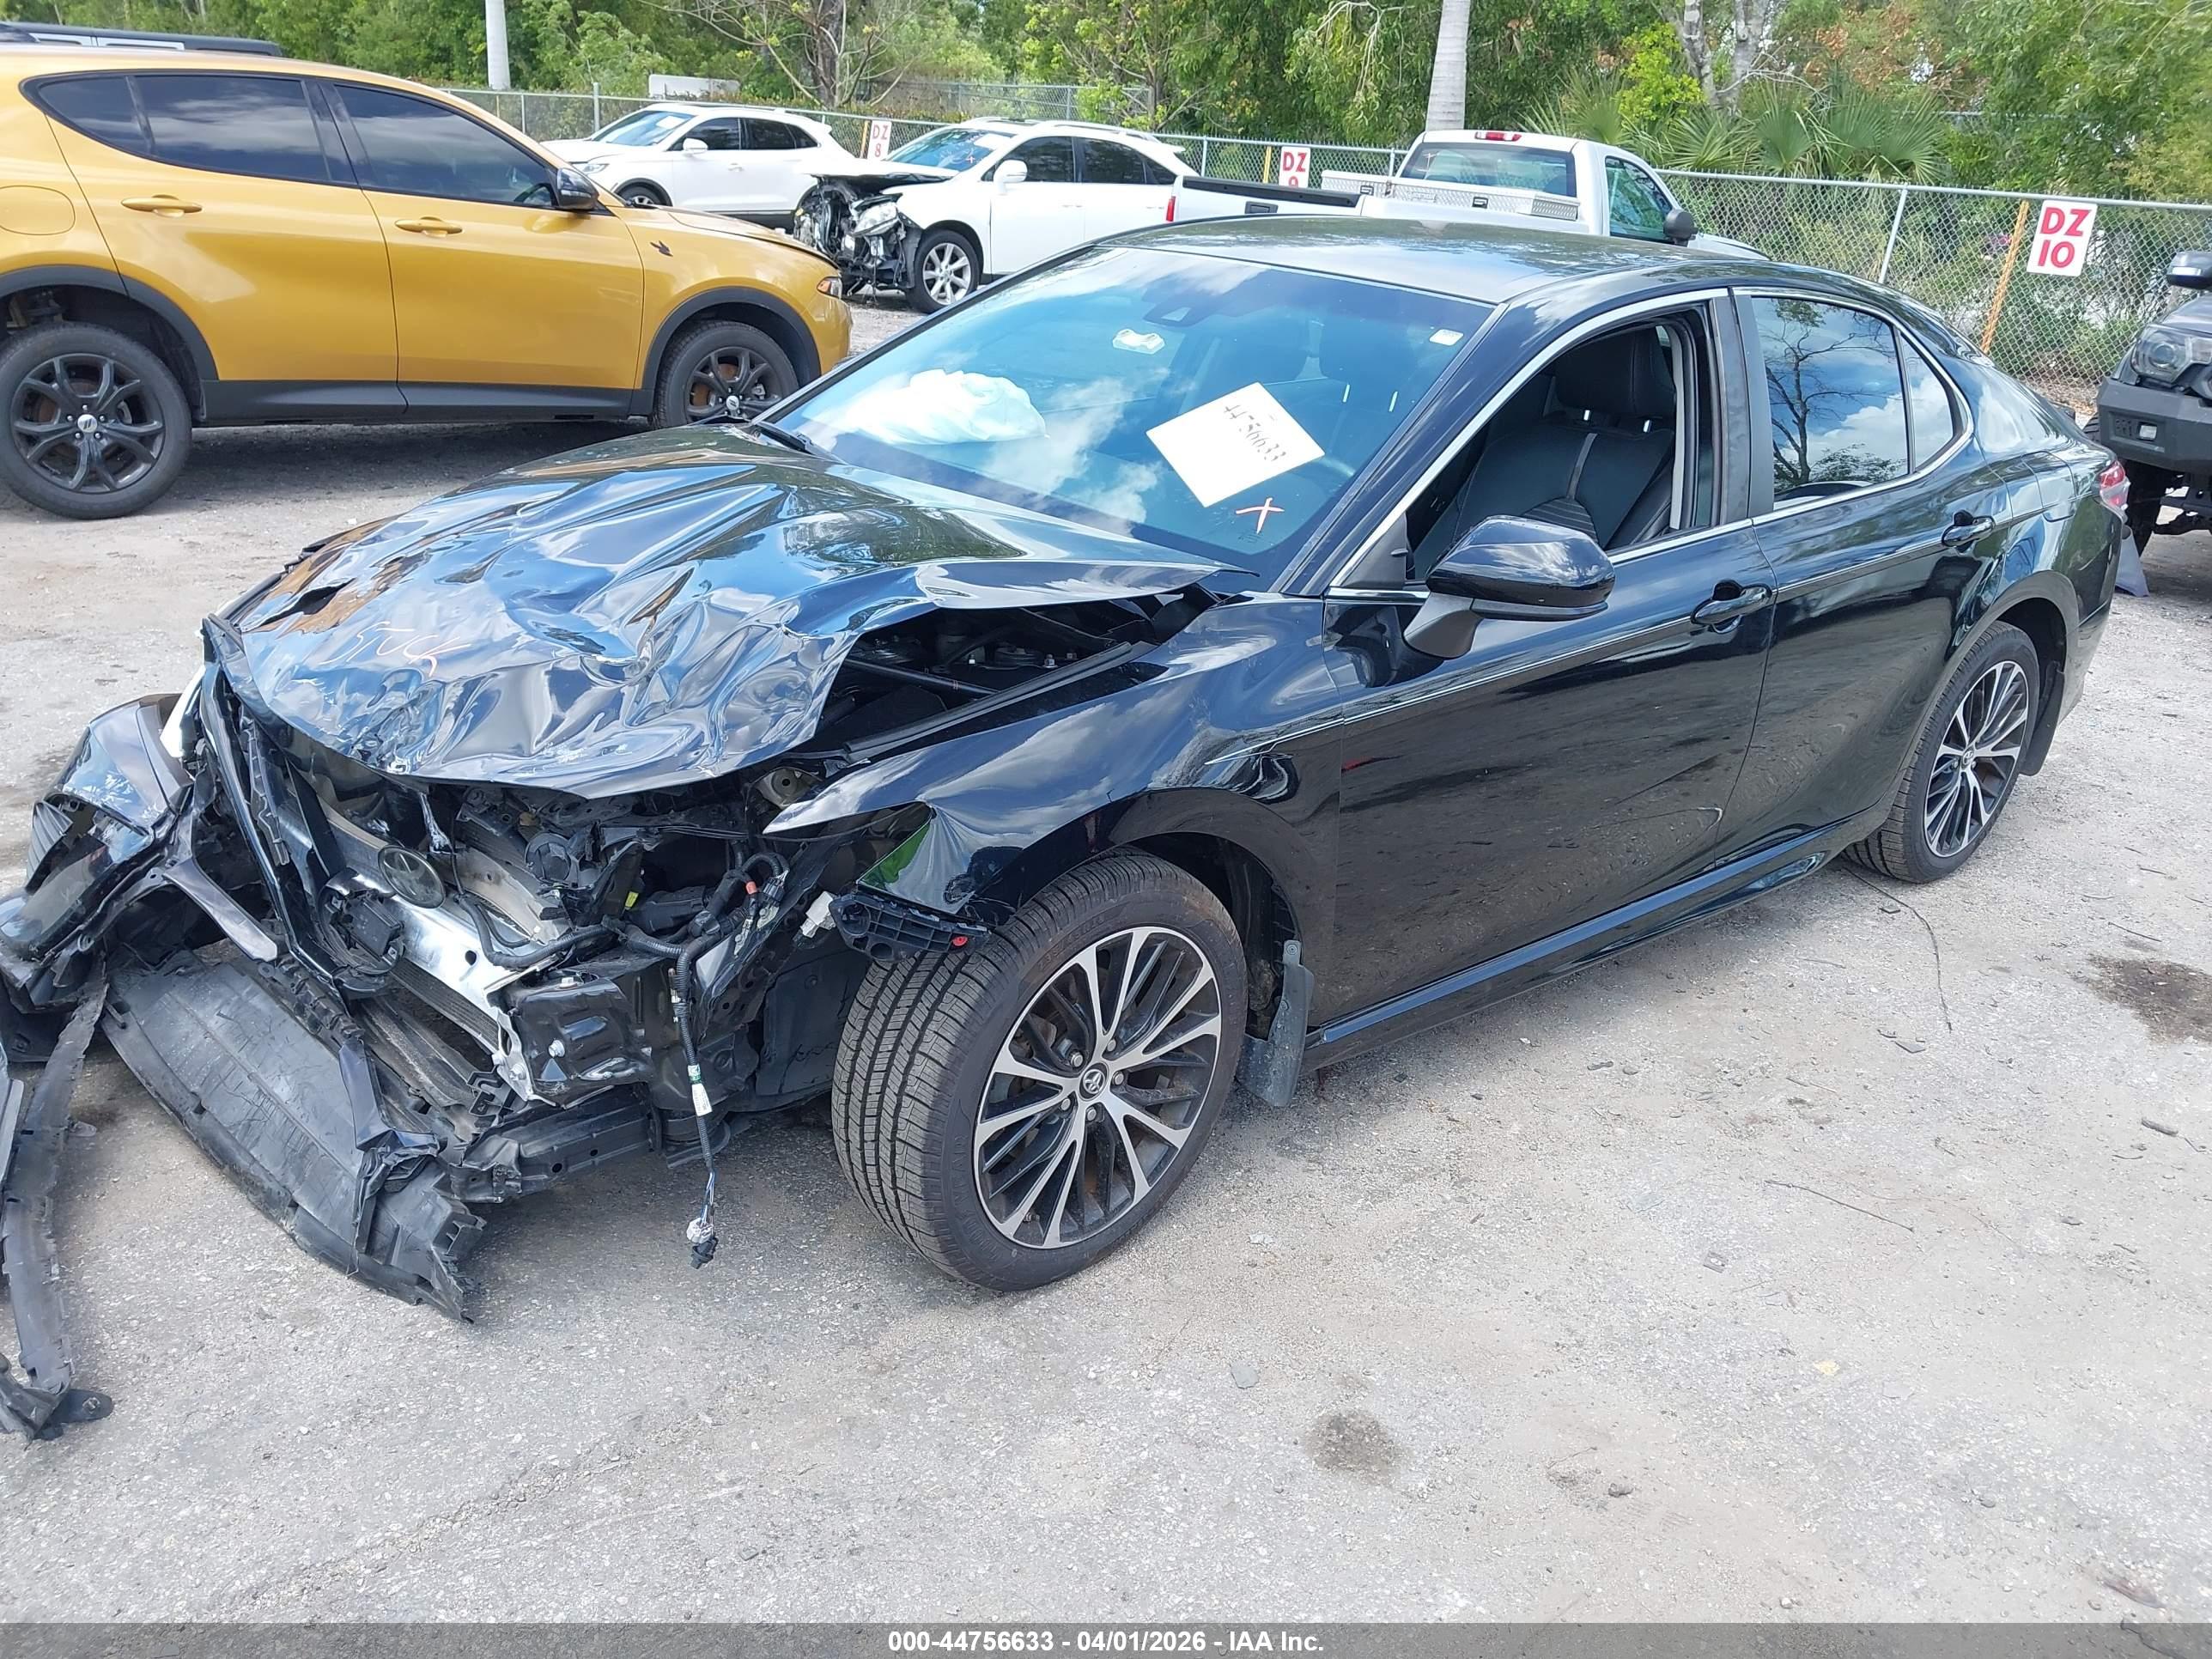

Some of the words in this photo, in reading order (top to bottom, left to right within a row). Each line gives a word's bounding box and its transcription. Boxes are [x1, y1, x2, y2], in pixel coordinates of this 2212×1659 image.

[872, 124, 889, 140] DZ
[874, 143, 882, 158] 8
[1282, 151, 1308, 173] DZ
[2039, 207, 2092, 237] DZ
[2038, 240, 2075, 269] 10
